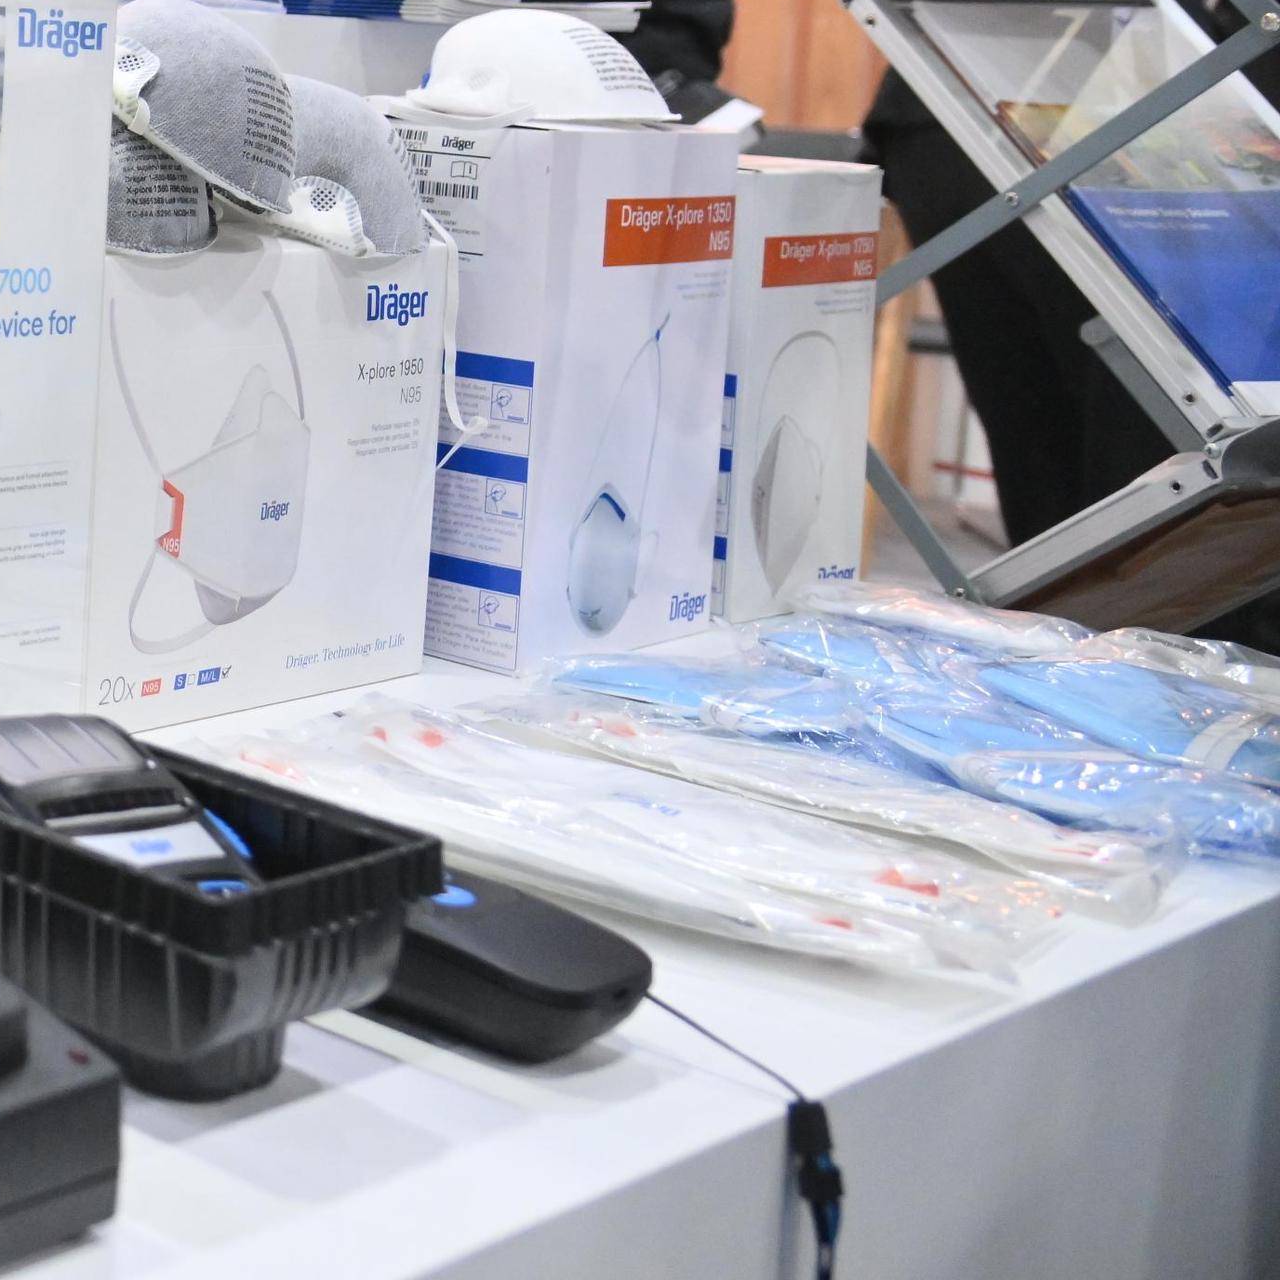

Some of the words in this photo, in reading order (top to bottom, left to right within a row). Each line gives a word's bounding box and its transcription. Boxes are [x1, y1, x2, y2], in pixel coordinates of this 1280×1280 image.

[17, 7, 108, 58] Dräger
[441, 136, 476, 151] Dräger
[621, 205, 662, 232] Dräger
[666, 204, 704, 230] X-plore
[708, 201, 732, 223] 1350
[709, 231, 730, 252] N95
[780, 240, 816, 263] Dräger
[818, 239, 851, 261] X-plore
[852, 259, 873, 276] N95
[366, 283, 429, 327] Dräger
[48, 311, 77, 335] for
[357, 361, 396, 385] X-plore
[399, 357, 424, 377] 1950
[400, 385, 422, 405] N95
[260, 500, 290, 521] Dräger
[162, 537, 180, 553] N95
[669, 592, 707, 622] Dräger
[322, 641, 372, 662] Technology
[374, 637, 387, 651] for
[389, 632, 405, 648] Life
[98, 676, 136, 706] 20x
[142, 682, 159, 694] N95
[176, 676, 184, 687] S
[200, 668, 217, 683] M/L
